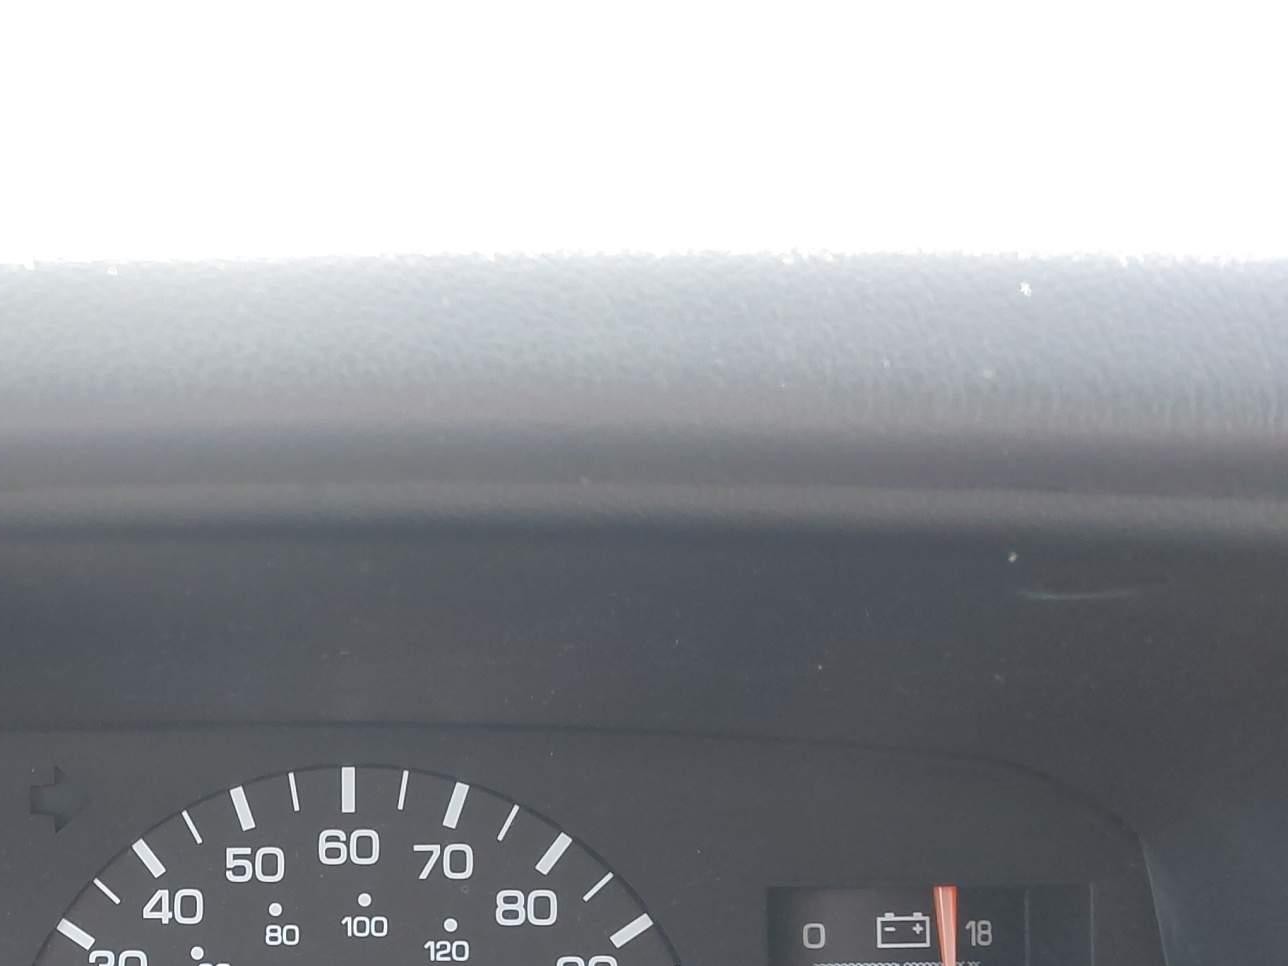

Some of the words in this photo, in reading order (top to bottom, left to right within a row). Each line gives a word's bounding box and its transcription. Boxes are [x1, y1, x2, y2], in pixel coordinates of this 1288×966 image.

[225, 846, 285, 883] 50
[318, 829, 380, 865] 60
[413, 843, 474, 880] 70
[142, 888, 204, 925] 40
[495, 889, 558, 926] 80
[265, 924, 300, 946] 80
[341, 916, 388, 937] 100
[965, 919, 993, 947] 18
[423, 940, 470, 962] 120
